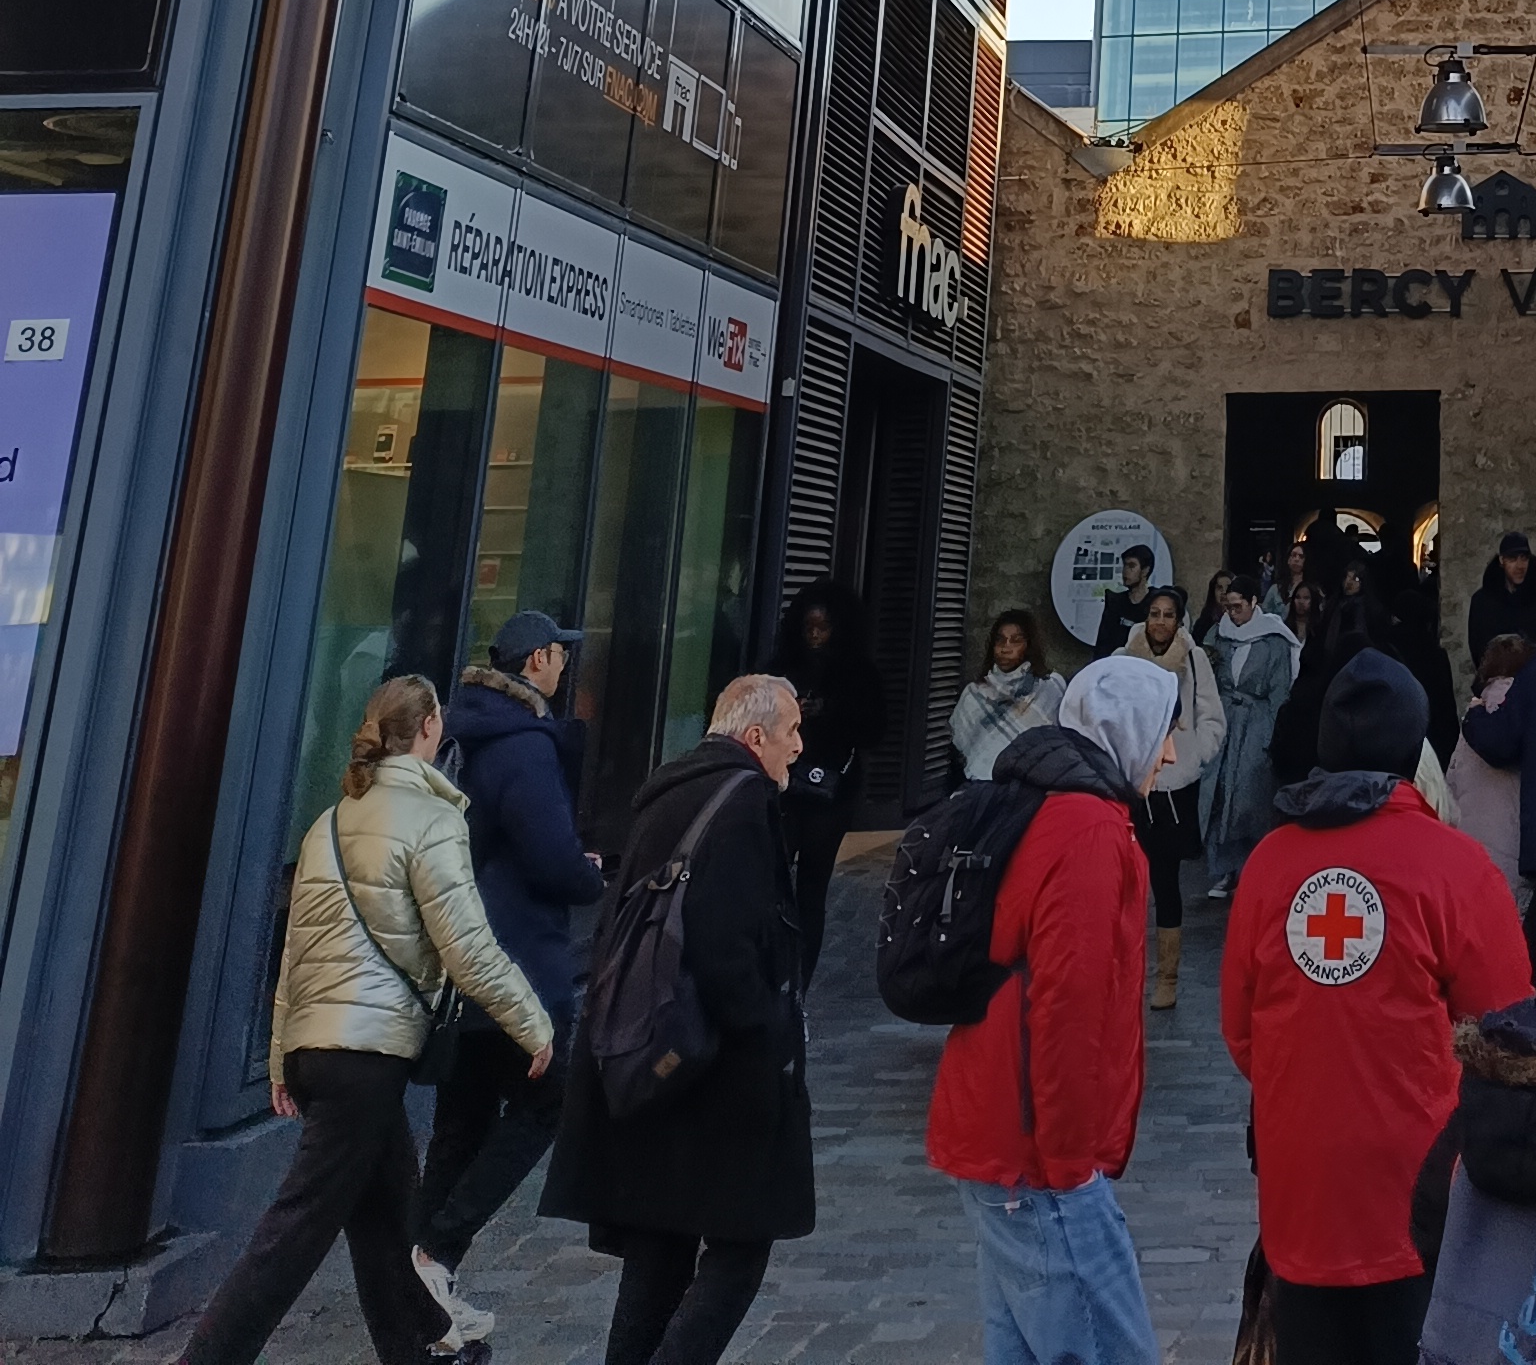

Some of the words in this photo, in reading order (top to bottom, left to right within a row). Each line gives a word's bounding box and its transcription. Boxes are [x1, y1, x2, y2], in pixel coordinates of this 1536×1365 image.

[557, 36, 582, 76] 7J/7
[582, 51, 606, 90] SUR
[613, 19, 663, 80] SERVICE
[673, 76, 691, 103] fnac
[447, 213, 549, 300] RÉPARATION
[547, 257, 609, 321] EXPRESS
[897, 183, 960, 328] fnac
[1267, 268, 1476, 319] BERCY
[18, 326, 56, 353] 38
[1114, 523, 1141, 531] VILLAGE
[1293, 872, 1379, 916] CROIX-ROUGE
[1297, 951, 1371, 984] FRANÇAISE
